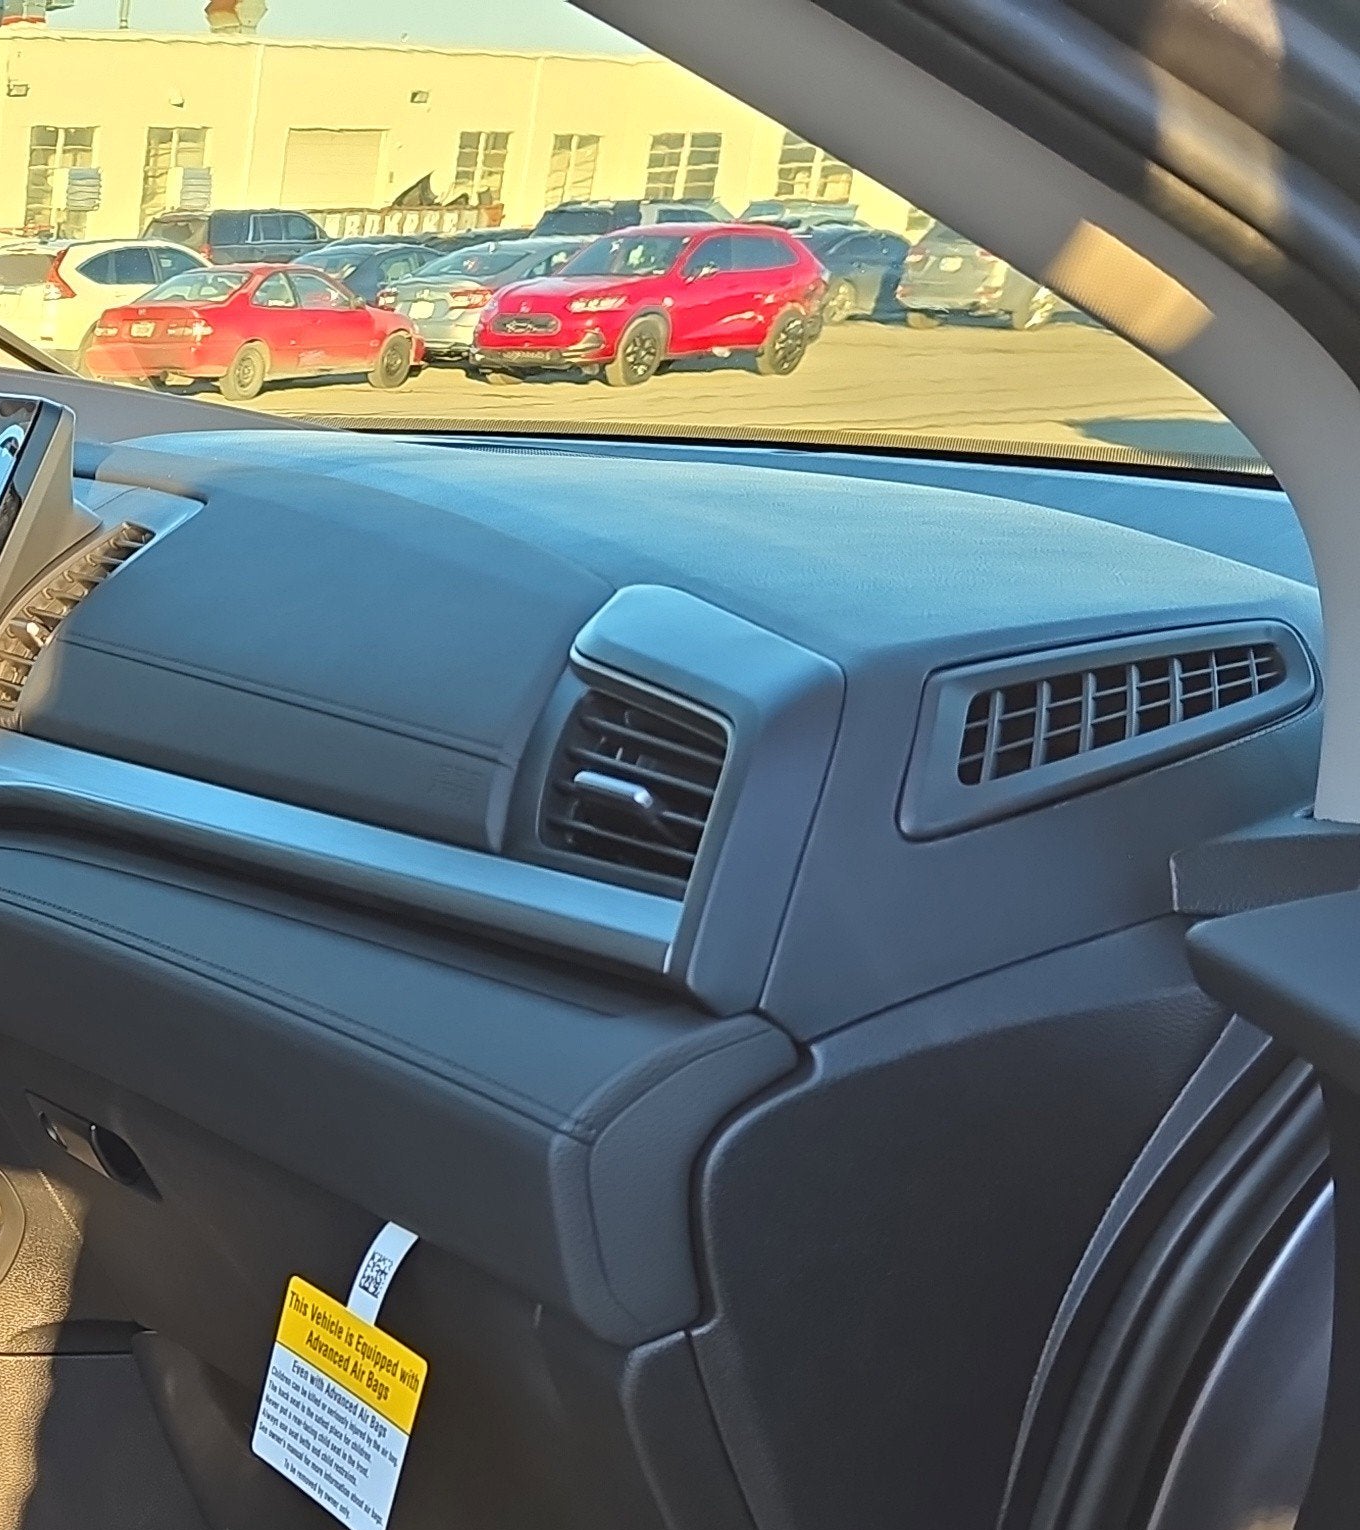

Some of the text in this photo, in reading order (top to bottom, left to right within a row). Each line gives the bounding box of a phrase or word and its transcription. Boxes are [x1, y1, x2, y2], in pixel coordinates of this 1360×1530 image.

[287, 1290, 421, 1393] This Vehicle is Equipped with
[305, 1328, 391, 1404] Advanced Air Bags
[268, 1379, 277, 1392] The
[271, 1364, 291, 1386] Children
[291, 1380, 300, 1393] can
[300, 1386, 307, 1397] be
[291, 1359, 388, 1441] Even with Advanced Air Bags
